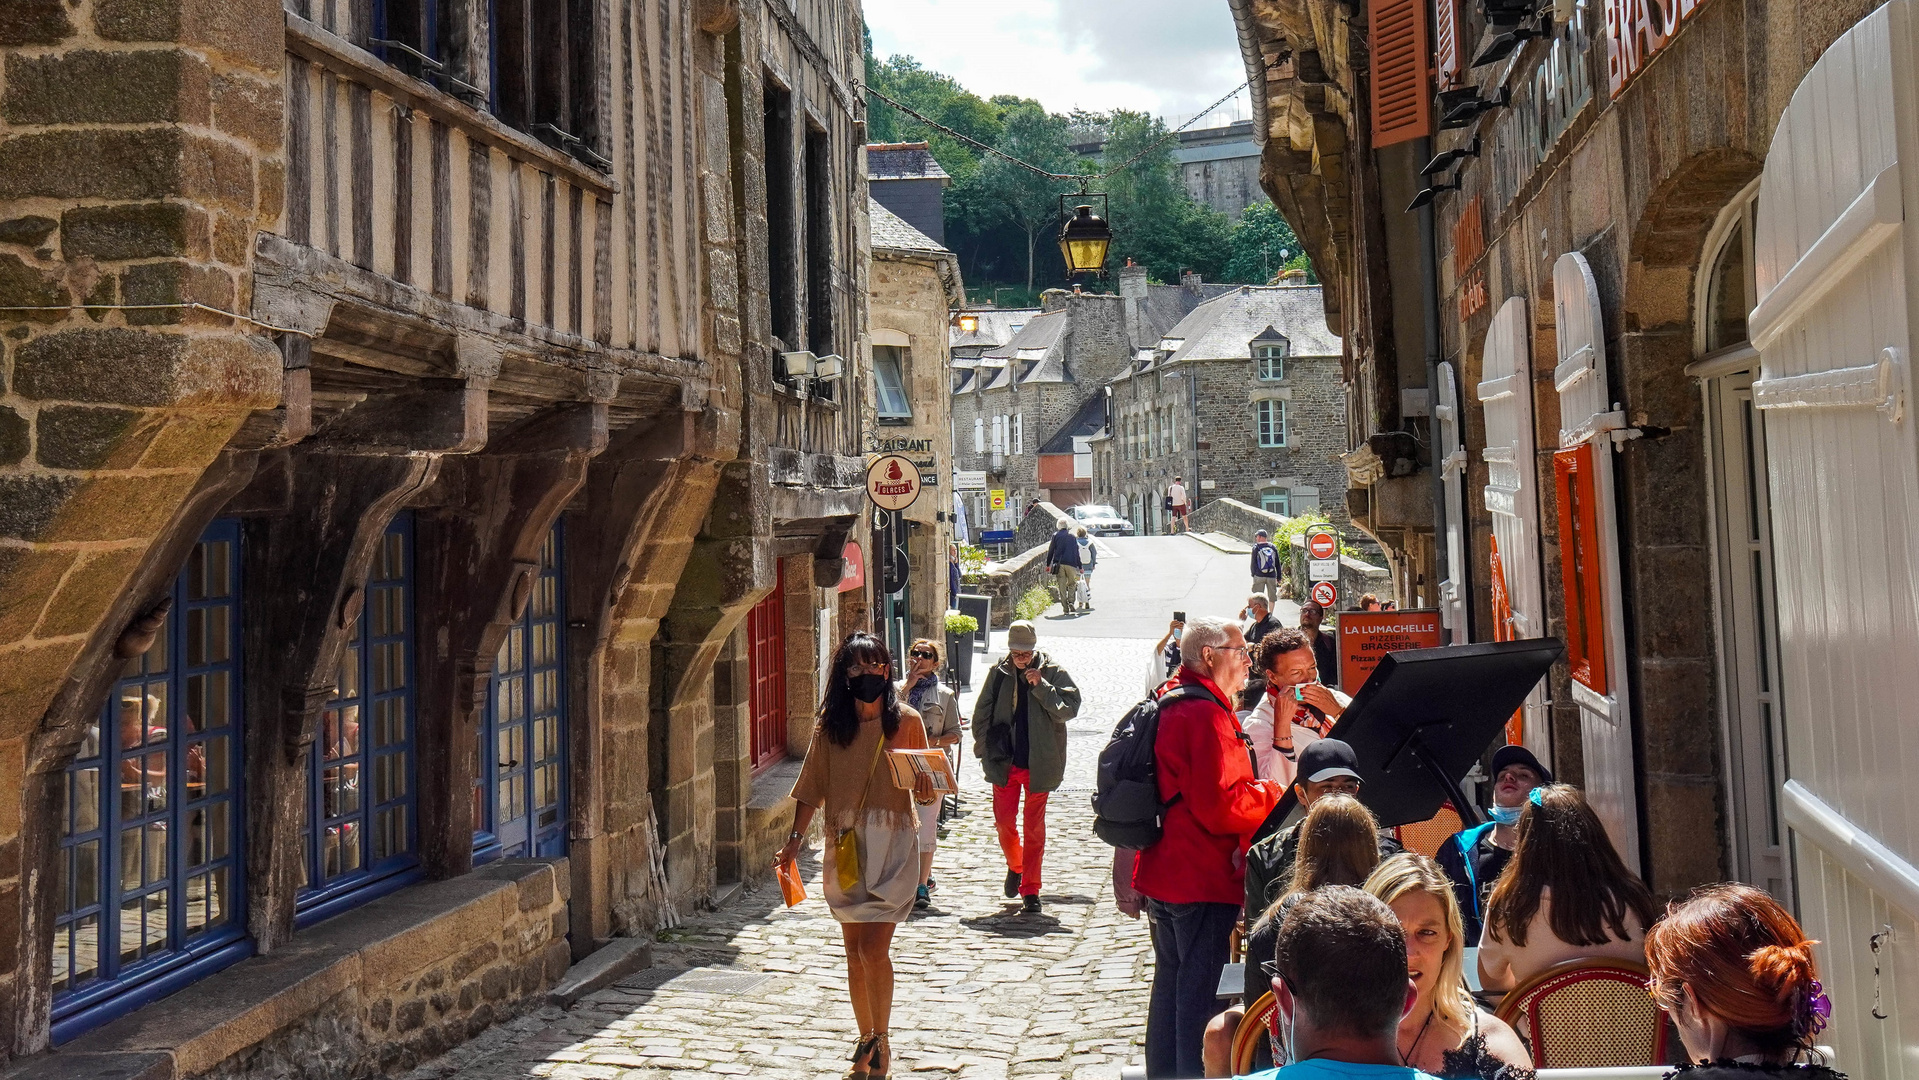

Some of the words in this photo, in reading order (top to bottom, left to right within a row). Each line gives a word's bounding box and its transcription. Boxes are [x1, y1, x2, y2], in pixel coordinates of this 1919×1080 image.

[881, 486, 906, 494] GLACES
[1345, 626, 1359, 634] LA
[1361, 624, 1435, 634] LUMACHELLE
[1369, 634, 1411, 642] PIZZERIA
[1361, 642, 1422, 651] BRASSERIE
